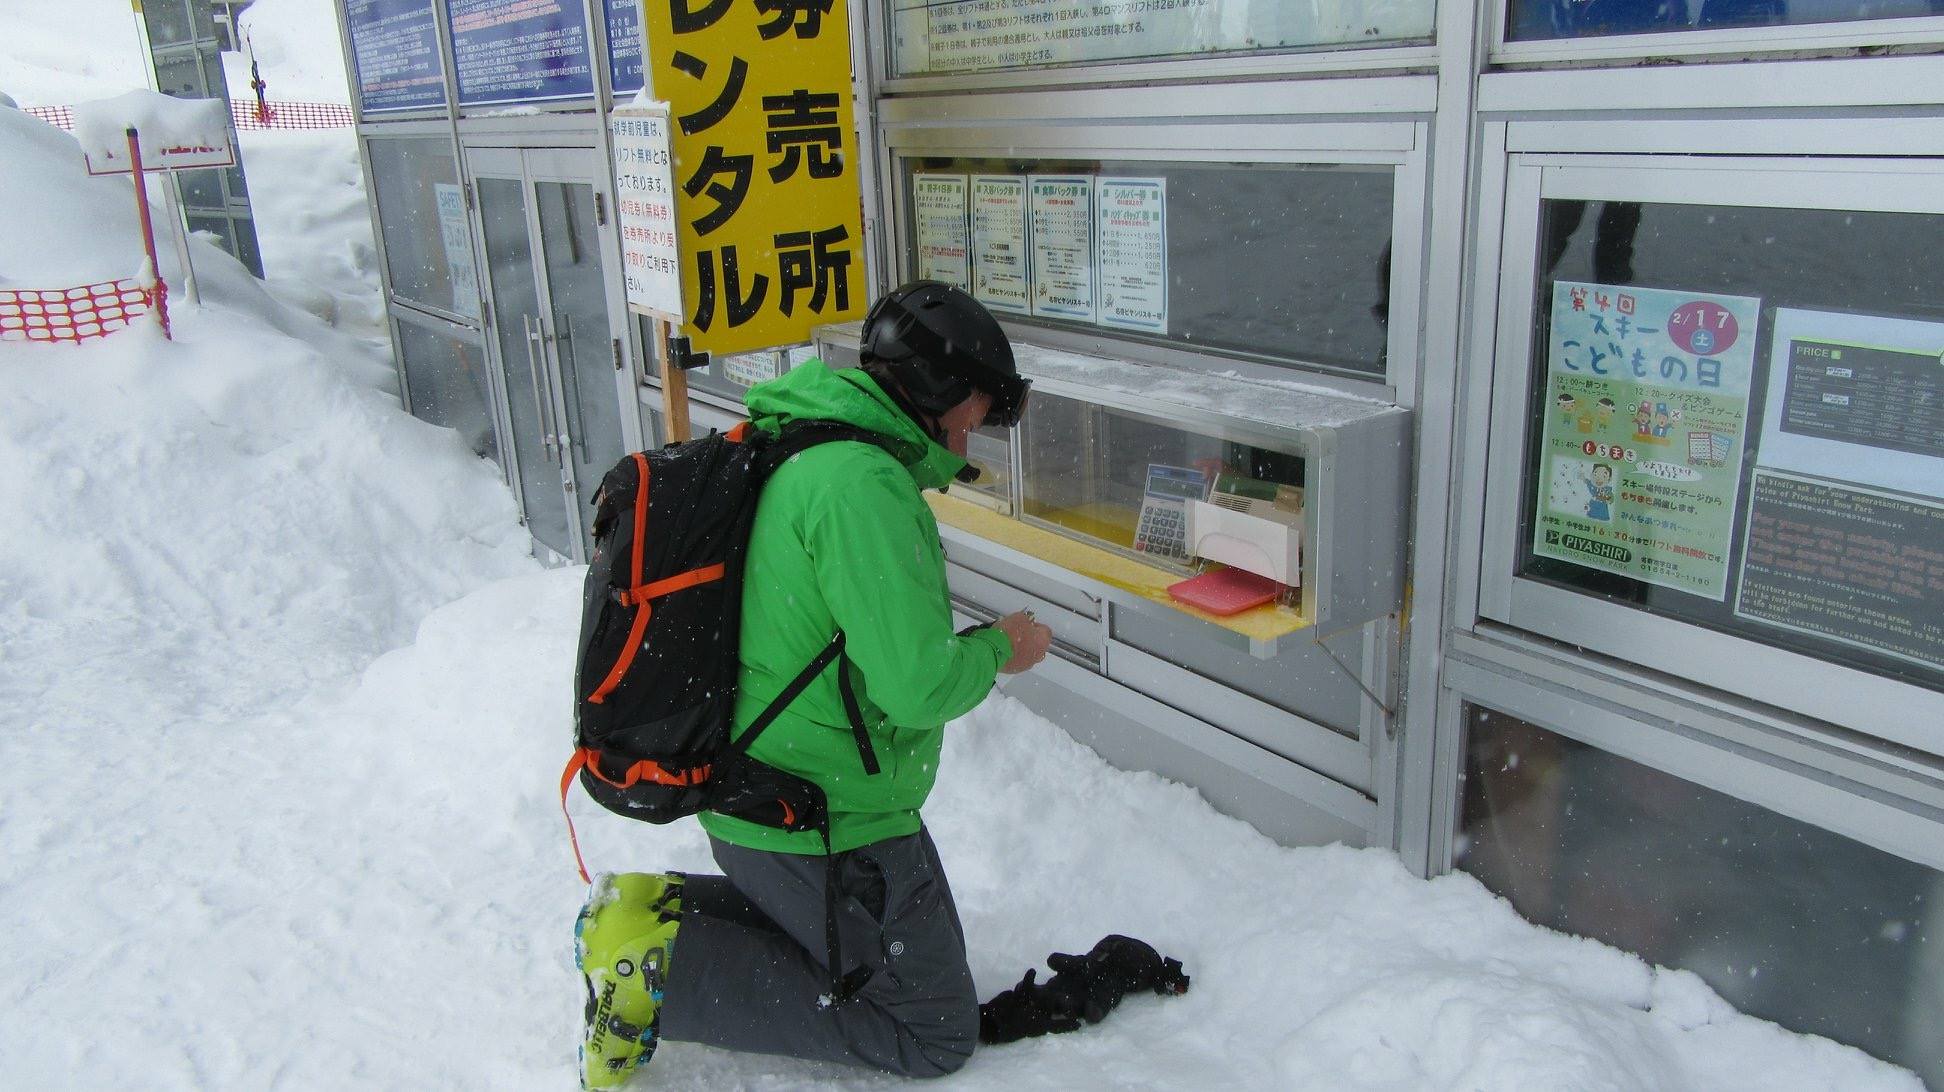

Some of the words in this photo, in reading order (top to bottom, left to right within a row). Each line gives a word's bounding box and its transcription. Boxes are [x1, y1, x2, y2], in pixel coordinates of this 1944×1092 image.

[616, 147, 668, 166] リフト無料とな
[1589, 314, 1660, 339] スキー
[1673, 309, 1730, 328] 2/17
[1695, 333, 1708, 346] 土
[1796, 346, 1829, 358] PRICE
[1563, 341, 1722, 387] こどもの日
[1814, 487, 1826, 495] for
[1831, 491, 1848, 500] your
[1566, 536, 1628, 561] PIYASHIRI
